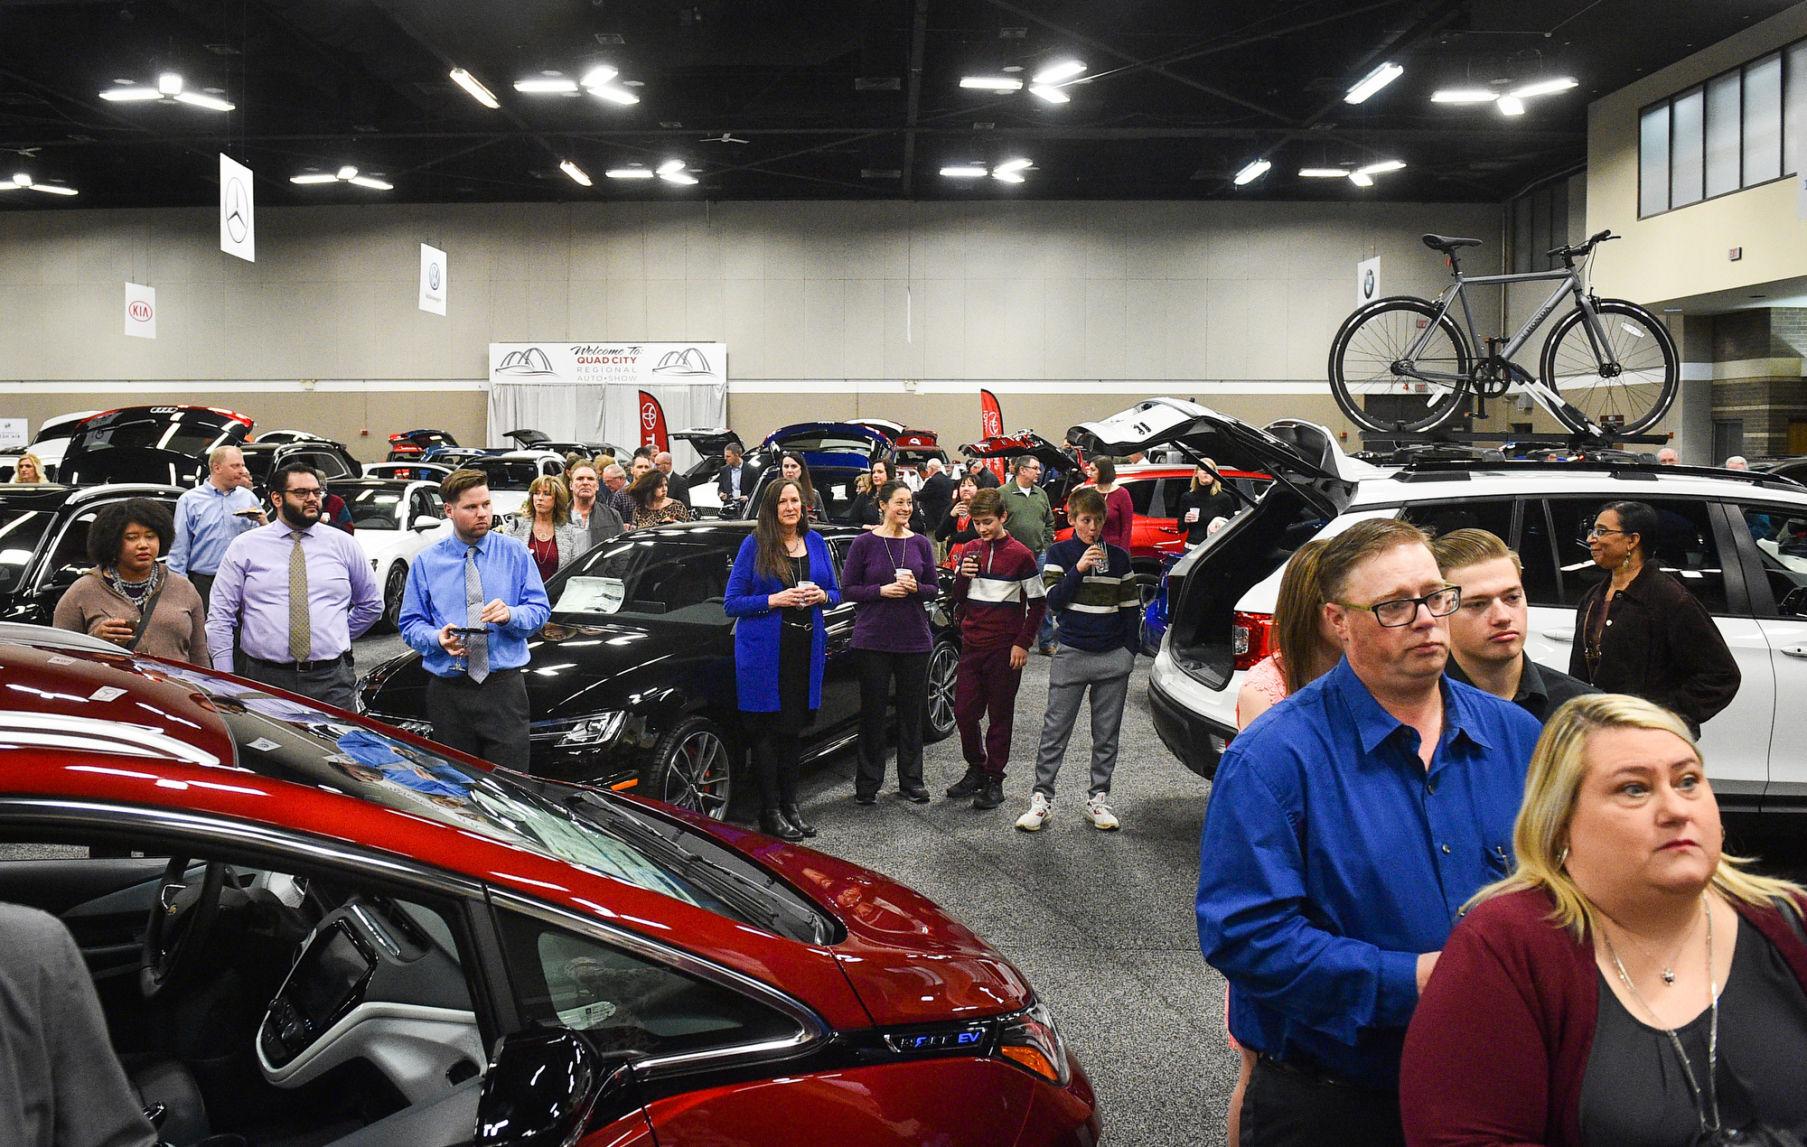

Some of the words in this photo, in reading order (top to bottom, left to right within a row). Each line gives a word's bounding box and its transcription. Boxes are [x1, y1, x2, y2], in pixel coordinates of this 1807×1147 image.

[132, 304, 149, 318] KIA
[570, 345, 624, 355] Welcome
[627, 345, 643, 355] To
[577, 356, 609, 364] QUAD
[611, 356, 637, 364] CITY
[958, 1031, 980, 1044] EV
